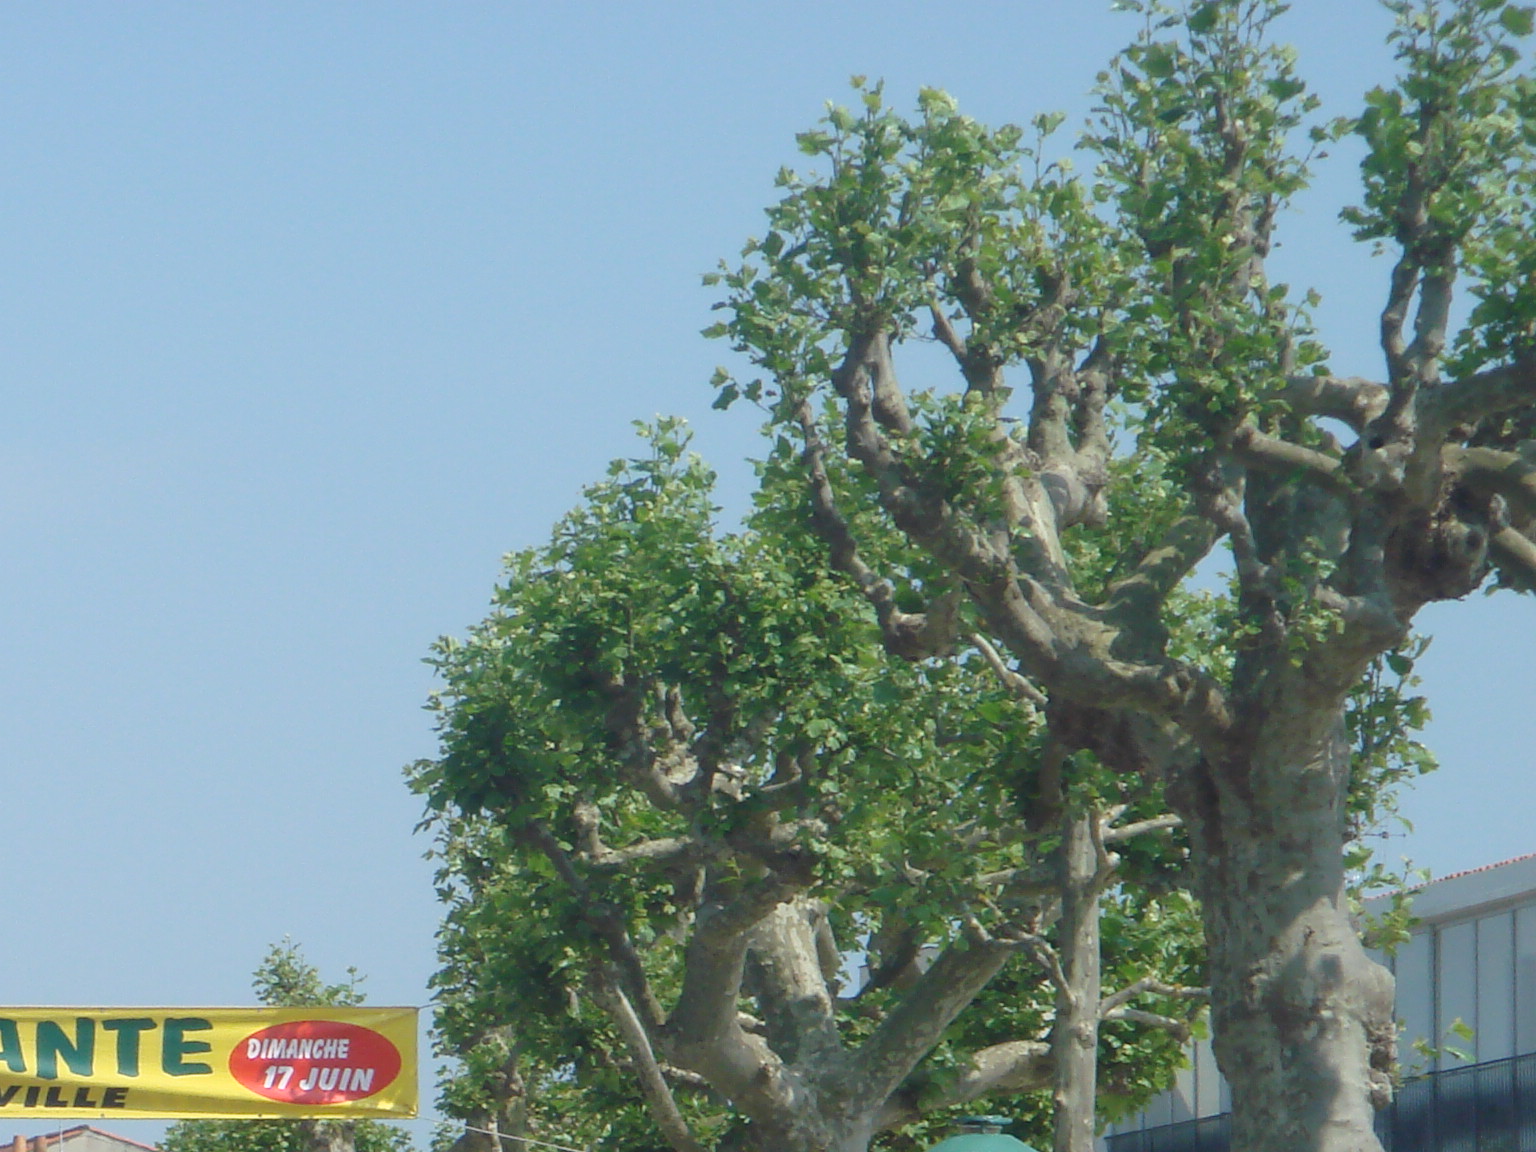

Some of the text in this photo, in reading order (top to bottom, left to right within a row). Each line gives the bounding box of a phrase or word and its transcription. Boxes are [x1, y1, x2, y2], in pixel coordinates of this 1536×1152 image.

[247, 1038, 350, 1060] DIMANCHE
[264, 1065, 375, 1092] 17 JUIN
